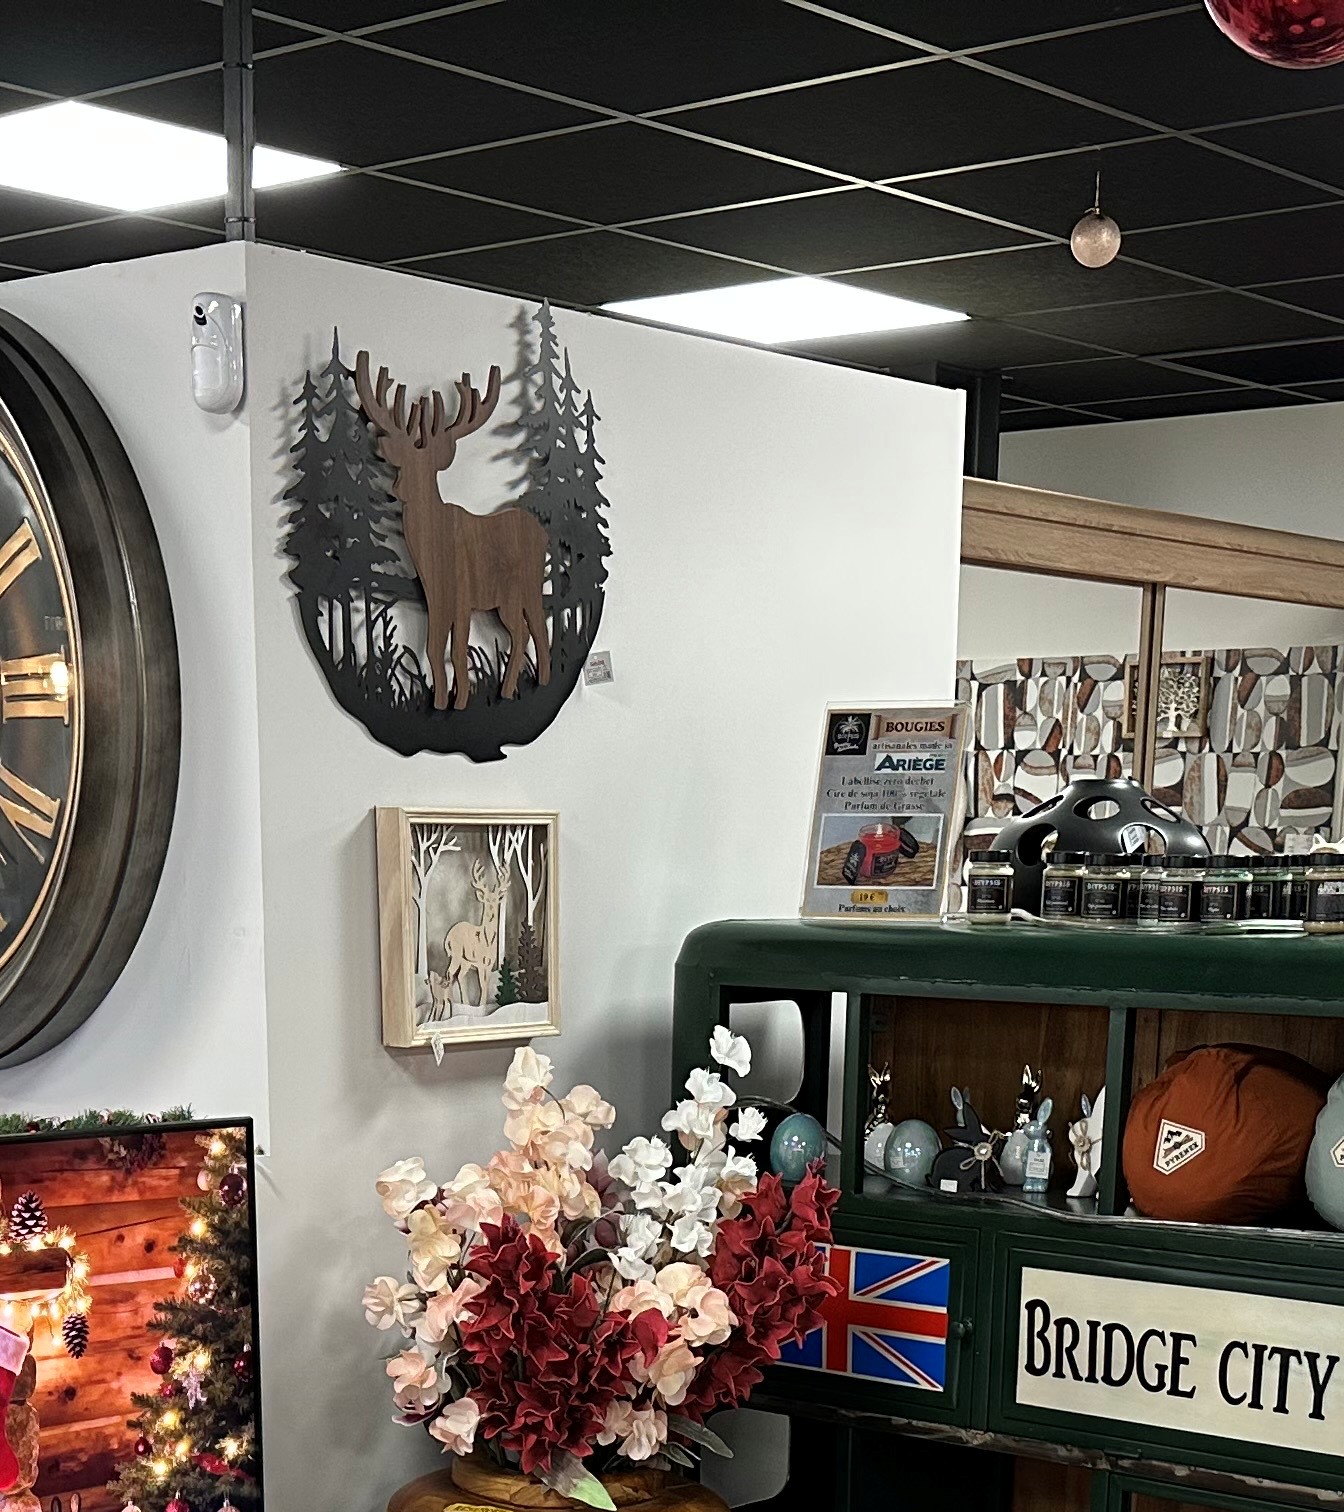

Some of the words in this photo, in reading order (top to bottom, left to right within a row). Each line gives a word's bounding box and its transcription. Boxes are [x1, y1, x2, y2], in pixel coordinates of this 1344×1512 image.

[885, 721, 945, 733] BOUGIES
[848, 789, 858, 798] de
[844, 801, 878, 811] Parfum
[880, 801, 889, 811] de
[839, 904, 871, 912] Parfums
[884, 904, 906, 912] choix
[1165, 1142, 1200, 1168] PYRENEX
[1023, 1298, 1197, 1399] BRIDGE
[1218, 1340, 1339, 1422] CITY
